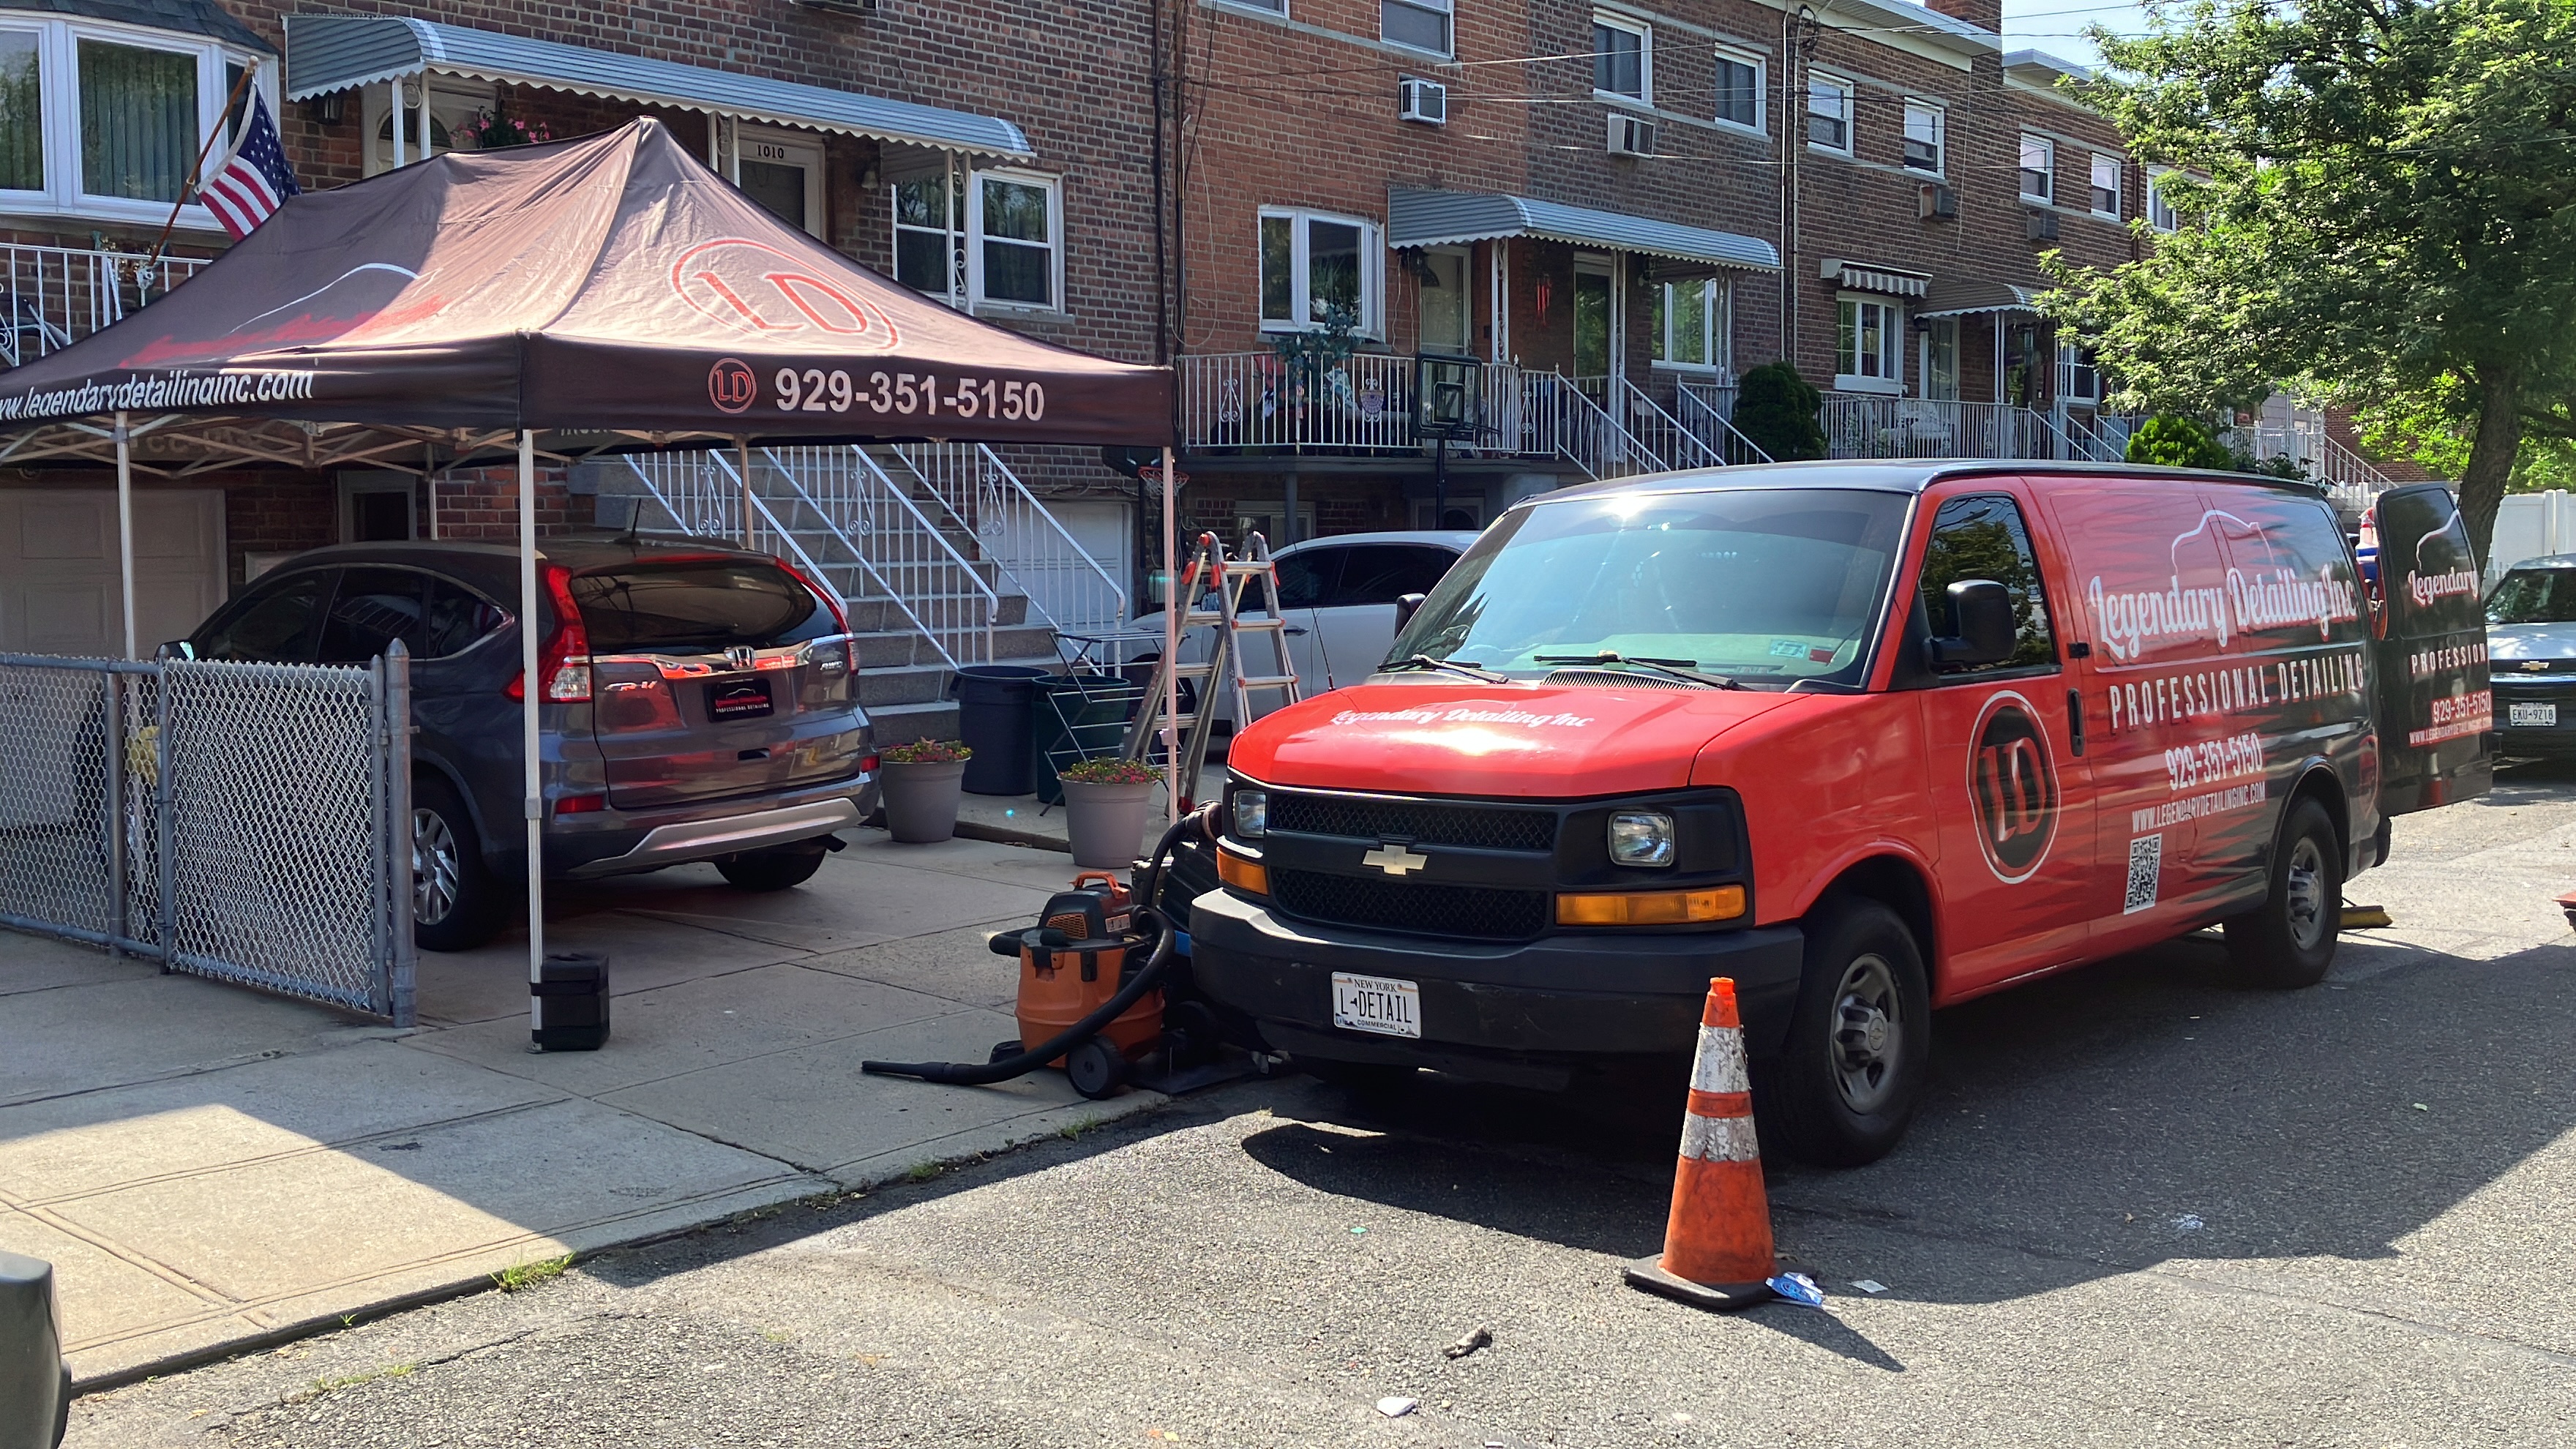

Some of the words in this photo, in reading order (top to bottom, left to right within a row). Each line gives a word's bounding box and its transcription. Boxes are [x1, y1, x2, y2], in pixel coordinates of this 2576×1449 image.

[757, 144, 785, 159] 1010
[693, 270, 869, 335] LD
[775, 367, 1045, 422] 929-351-5150
[2408, 566, 2479, 604] Legendary
[2089, 575, 2228, 659] Legendary
[2411, 643, 2486, 673] PROFESSION
[2110, 664, 2269, 729] PROFESSIONAL
[2277, 653, 2364, 700] DETAILING
[2433, 691, 2491, 724] 929-351-5150
[1330, 710, 1444, 724] Legendary
[1442, 708, 1554, 727] Detailing
[2165, 733, 2263, 790] 929-351-5150
[1979, 737, 2047, 842] LD
[2132, 781, 2266, 833] WWW.LEGENDARYDETAILINGINC.COM
[1354, 979, 1375, 989] NEW
[1375, 982, 1397, 993] YORK
[1357, 1019, 1397, 1030] COMMERCIAL
